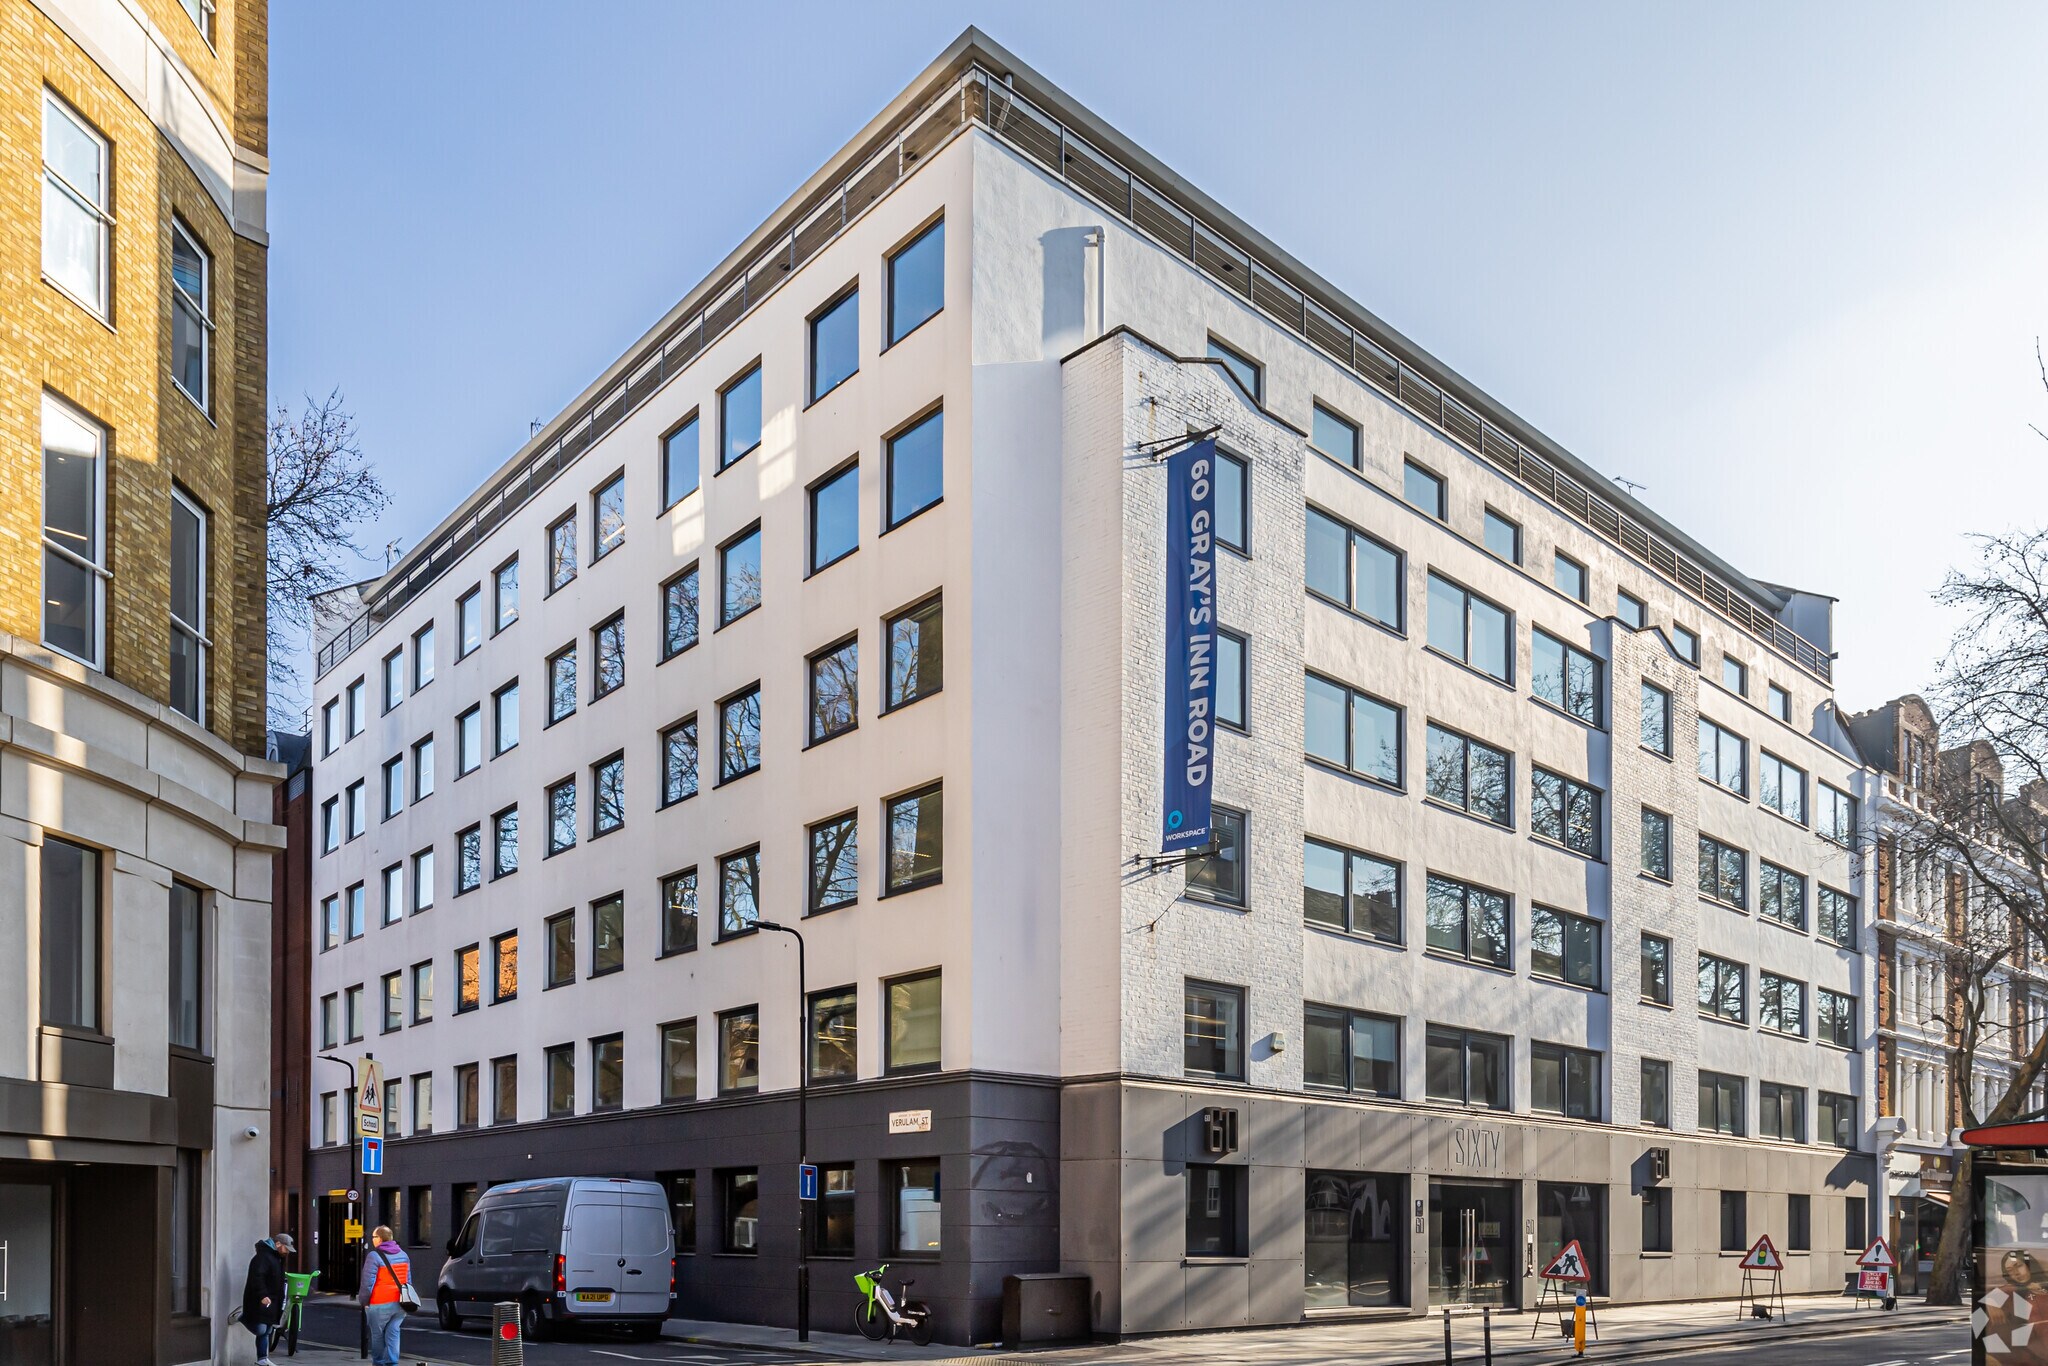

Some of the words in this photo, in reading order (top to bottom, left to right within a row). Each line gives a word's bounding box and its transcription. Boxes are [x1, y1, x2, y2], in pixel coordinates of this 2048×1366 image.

[1191, 460, 1209, 501] 60
[1190, 510, 1211, 625] GRAY'S
[1190, 634, 1210, 690] INN
[1187, 697, 1208, 786] ROAD
[1165, 827, 1206, 841] WORKSPACE
[891, 1117, 918, 1127] VERULAM
[1210, 1107, 1238, 1152] 60
[1455, 1127, 1500, 1168] SIXTY
